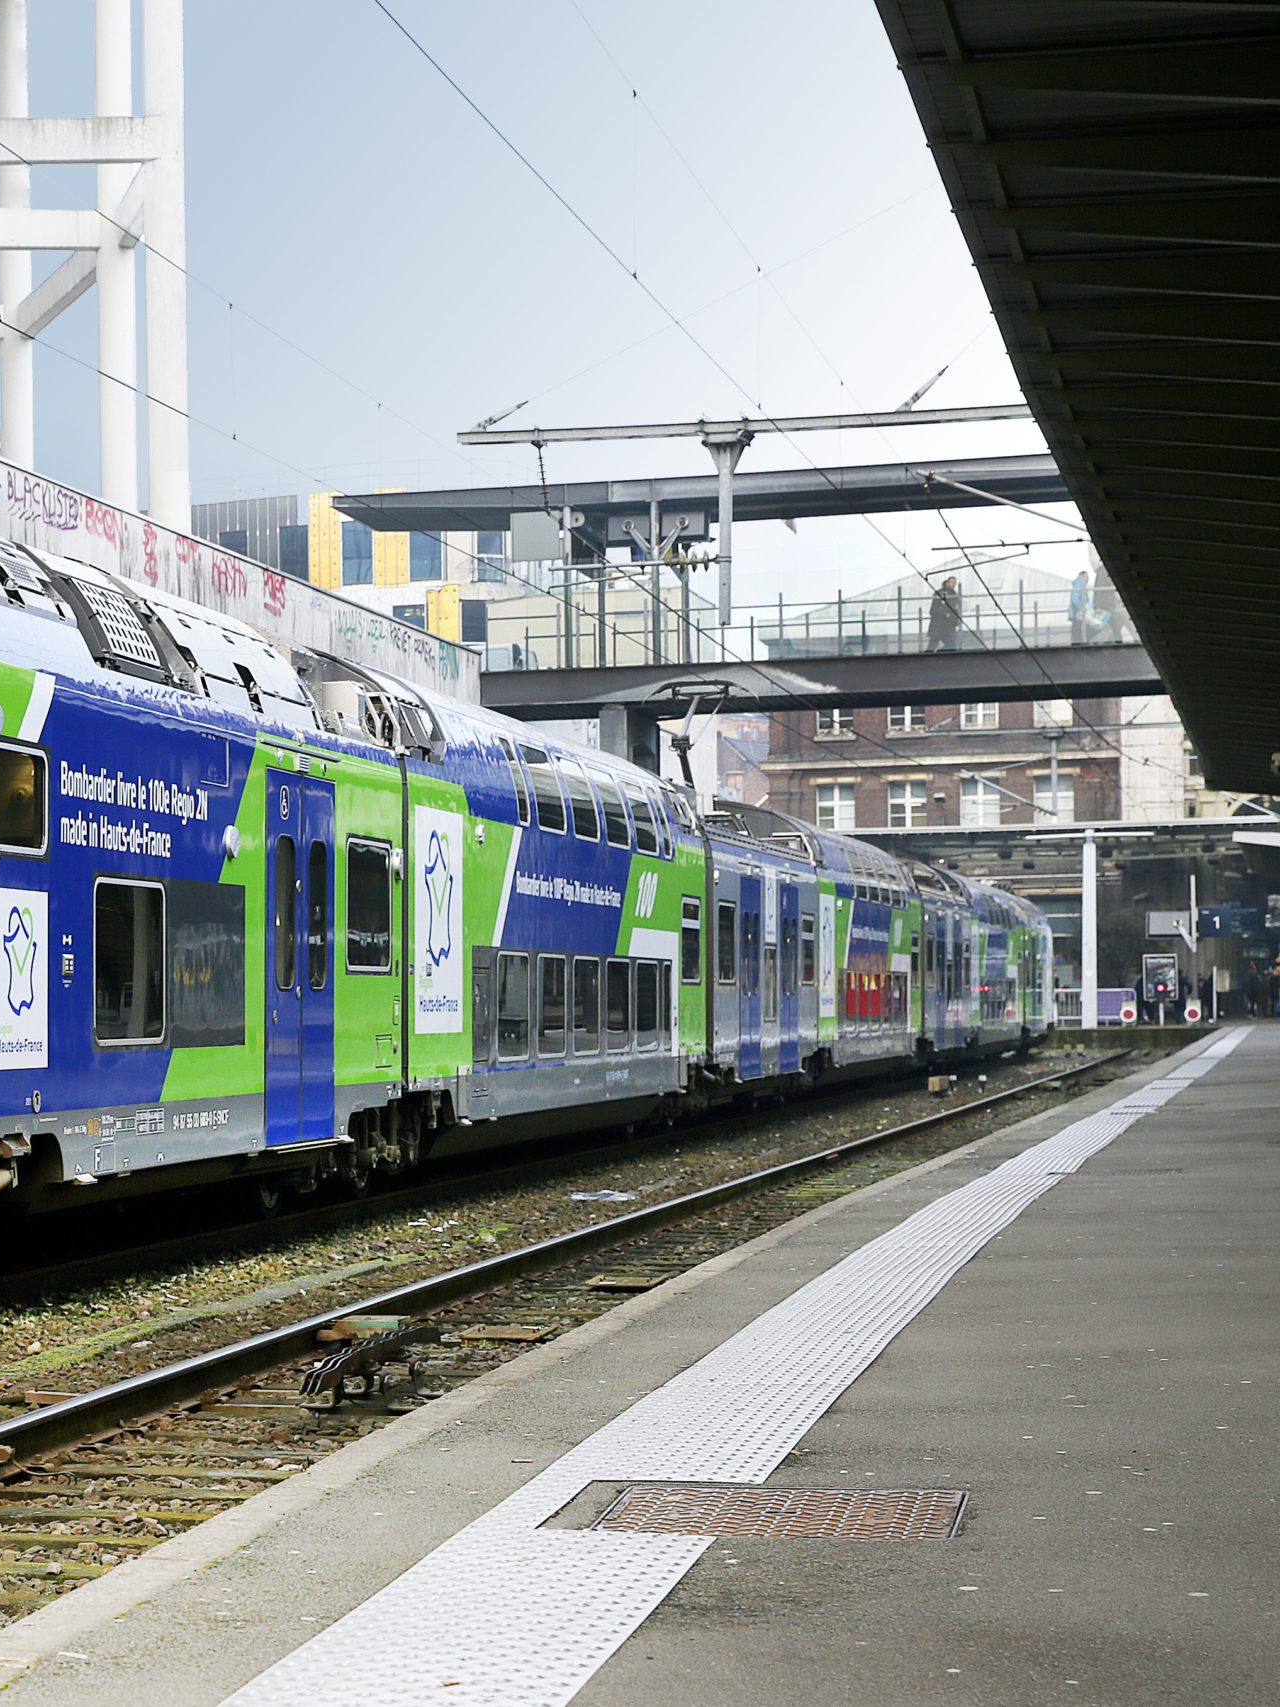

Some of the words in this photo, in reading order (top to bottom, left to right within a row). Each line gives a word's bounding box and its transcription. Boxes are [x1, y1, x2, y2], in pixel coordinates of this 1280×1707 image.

[60, 760, 116, 803] Bombardier
[117, 771, 137, 808] livre
[138, 775, 146, 810] le
[148, 778, 170, 814] 100e
[171, 783, 195, 825] Regio
[195, 788, 208, 821] 2N
[60, 810, 87, 846] made
[89, 812, 98, 848] in
[100, 815, 171, 858] Hauts-de-France
[634, 870, 659, 919] 100
[1212, 915, 1220, 929] 1
[419, 995, 458, 1012] Hauts-de-France
